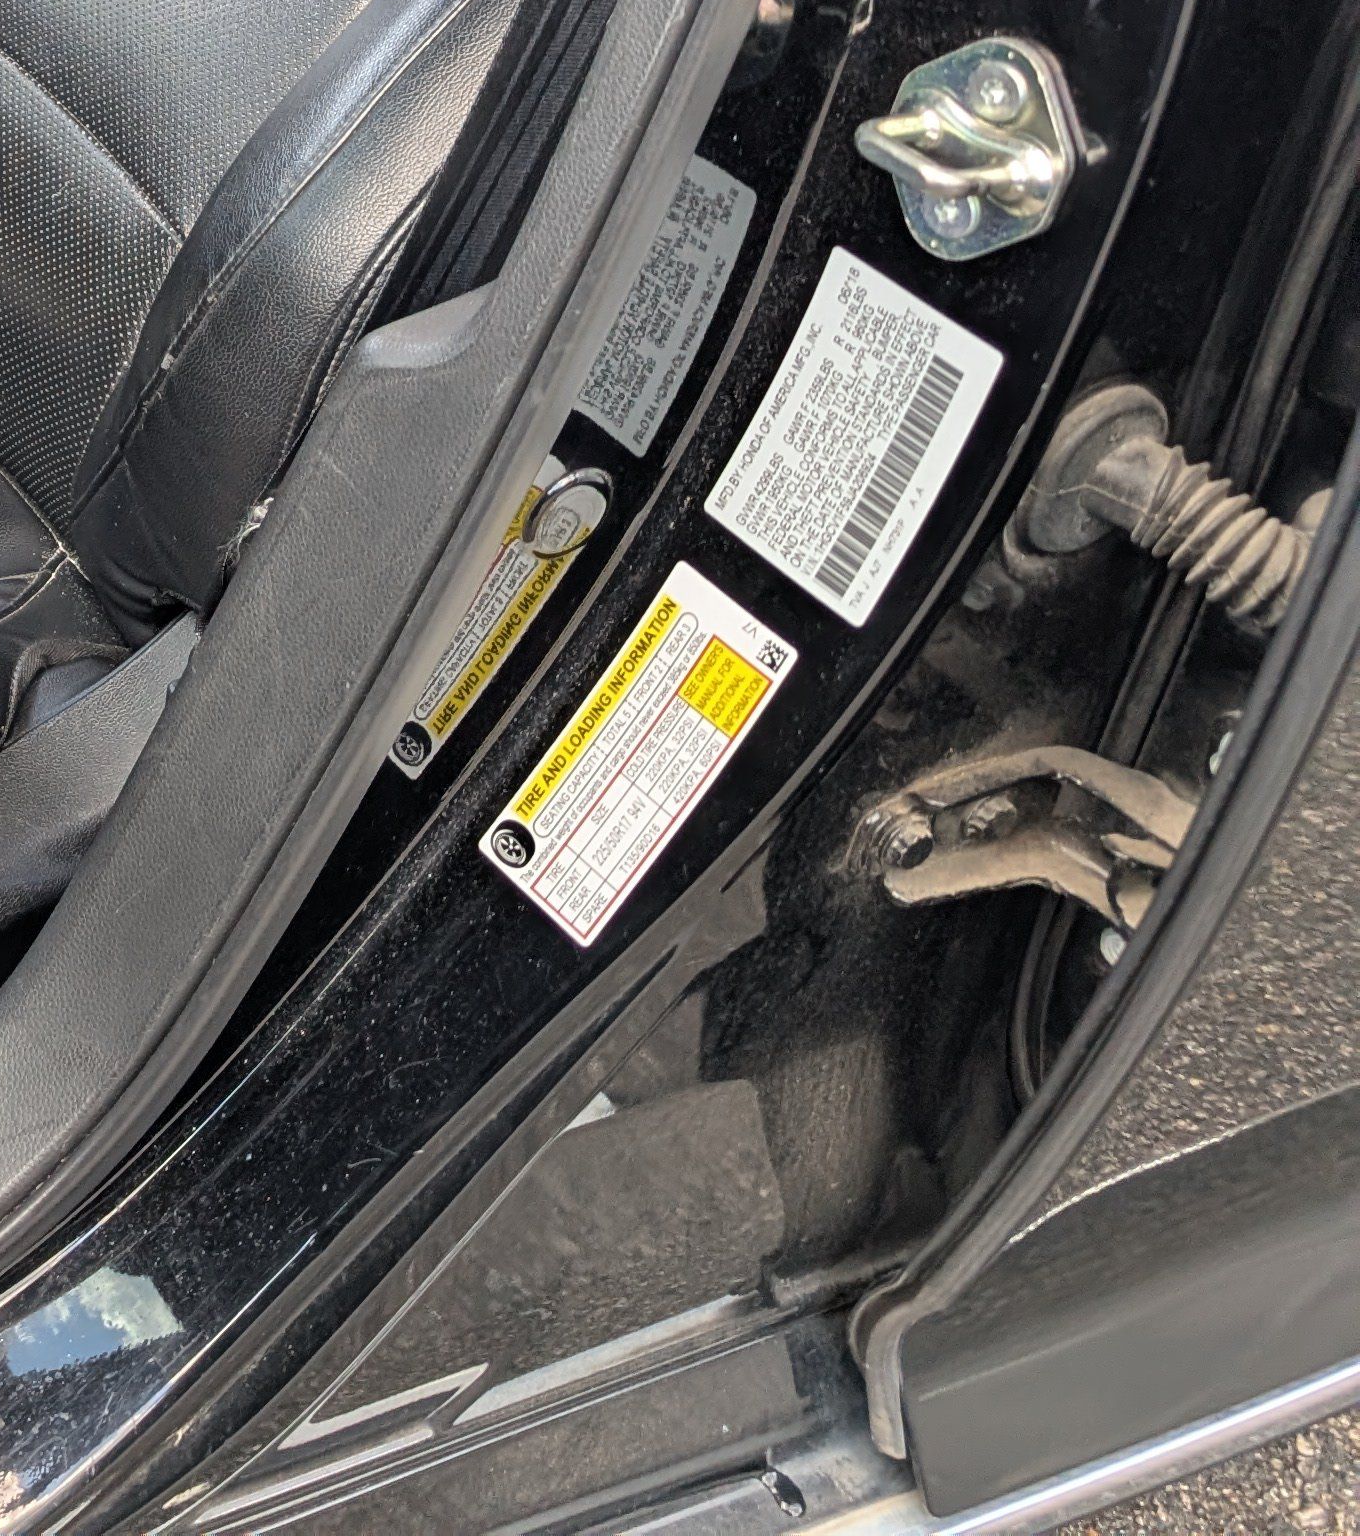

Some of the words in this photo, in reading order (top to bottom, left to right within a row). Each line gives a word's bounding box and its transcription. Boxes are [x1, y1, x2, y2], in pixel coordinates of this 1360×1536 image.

[834, 265, 863, 306] 06/18
[837, 284, 870, 333] 2116LBS
[849, 302, 876, 341] 960KG
[833, 334, 845, 347] R
[843, 341, 856, 354] R
[847, 304, 890, 374] APPLICABLE
[888, 306, 919, 353] EFFECT
[921, 321, 942, 348] CAR
[884, 351, 897, 366] IN
[804, 356, 835, 404] 2359LBS
[816, 368, 844, 411] 1070KG
[831, 391, 847, 410] TO
[839, 371, 856, 394] ALL
[850, 364, 892, 431] STANDARDS
[737, 429, 766, 472] HONDA
[758, 415, 774, 435] OF
[766, 368, 799, 421] AMERICA
[799, 401, 811, 412] F
[811, 409, 822, 421] F
[781, 409, 807, 446] GAWR
[789, 547, 806, 569] ON
[799, 524, 820, 552] THE
[813, 496, 836, 529] DATE
[829, 479, 846, 500] OF
[838, 398, 889, 483] MANUFACTURE
[880, 356, 910, 401] SHOWN
[901, 317, 930, 359] ABOVE
[793, 417, 817, 454] GAWR
[797, 406, 838, 473] CONFORMS
[752, 449, 784, 499] 4299LBS
[764, 461, 793, 506] 1950KG
[767, 498, 802, 553] FEDERAL
[795, 459, 825, 504] MOTOR
[818, 413, 850, 463] VEHICLE
[812, 429, 857, 502] PREVENTION
[734, 492, 759, 528] GVWR
[771, 468, 804, 519] VEHICLE
[907, 496, 918, 509] A
[913, 484, 924, 497] A
[745, 500, 769, 536] GVWR
[756, 513, 778, 544] THIS
[792, 497, 819, 537] THEFT
[778, 532, 799, 561] AND
[664, 629, 686, 656] REAR
[681, 621, 691, 632] 3
[632, 670, 658, 703] FRONT
[653, 663, 663, 674] 2
[682, 679, 699, 699] SEE
[693, 643, 724, 682] OWNER'S
[695, 675, 723, 710] MANUAL
[717, 656, 735, 678] FOR
[516, 782, 545, 818] TIRE
[539, 752, 568, 787] AND
[562, 691, 613, 757] LOADING
[605, 597, 678, 695] INFORMATION
[707, 671, 746, 721] ADDITIONAL
[719, 674, 764, 732] INFORMATION
[602, 716, 626, 746] TOTAL
[622, 709, 631, 719] 5
[625, 753, 646, 778] COLD
[640, 736, 658, 758] TIRE
[652, 697, 686, 741] PRESSURE
[684, 727, 708, 756] 32PSI
[519, 866, 535, 885] The
[530, 836, 558, 872] combined
[553, 816, 575, 843] weight
[568, 808, 579, 821] of
[574, 777, 604, 814] occupants
[598, 763, 612, 780] and
[607, 745, 628, 769] cargo
[620, 723, 642, 750] should
[637, 705, 655, 727] never
[649, 681, 672, 708] exceed
[681, 652, 692, 663] or
[644, 742, 676, 783] 220KPA,
[671, 715, 695, 745] 32PSI
[539, 790, 571, 831] SEATING
[566, 750, 601, 795] CAPACITY
[671, 765, 703, 806] 420KPA,
[698, 737, 723, 768] 60PSI
[589, 802, 610, 826] SIZE
[591, 813, 633, 867] 225/50R17
[626, 795, 648, 820] 94V
[617, 820, 661, 876] T135/90D16
[546, 860, 565, 884] TIRE
[556, 867, 582, 900] FRONT
[568, 884, 591, 912] REAR
[581, 890, 609, 925] SPARE
